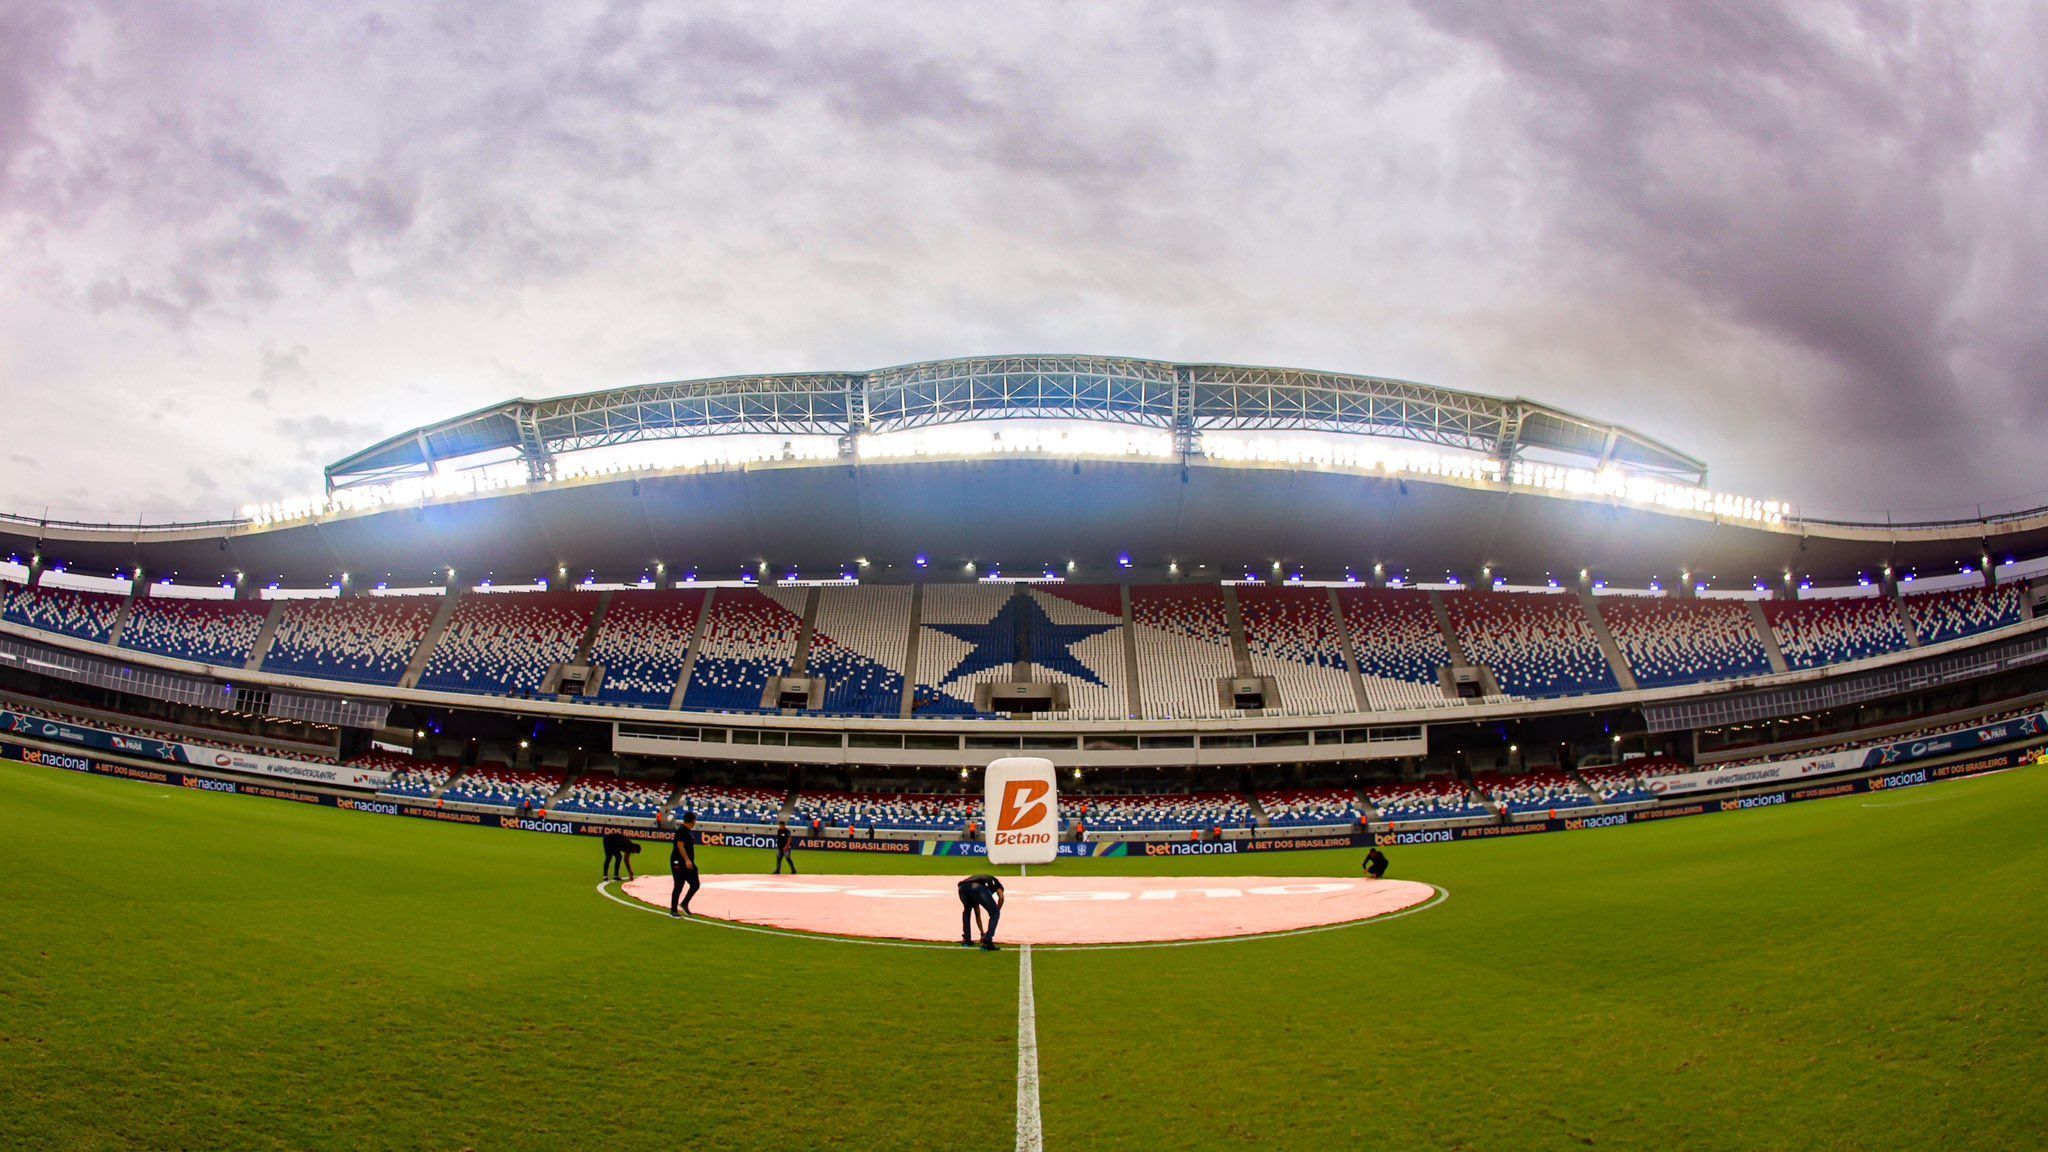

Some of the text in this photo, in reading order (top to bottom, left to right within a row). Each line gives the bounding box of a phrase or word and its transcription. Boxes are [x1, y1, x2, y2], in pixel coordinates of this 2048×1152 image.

[23, 747, 88, 770] betnacional
[1933, 768, 1939, 776] A
[1938, 766, 1950, 776] BET
[1951, 764, 1964, 774] DOS
[1966, 756, 2008, 772] BRASILEIROS
[96, 762, 166, 781] A BET DOS BRASILEIROS
[1868, 768, 1926, 790] betnacional
[183, 775, 236, 792] betnacional
[337, 797, 398, 815] betnacional
[1721, 792, 1786, 810] betnacional
[410, 808, 421, 816] BET
[423, 810, 437, 818] DOS
[438, 812, 480, 822] BRASILEIROS
[1565, 813, 1627, 830] betnacional
[500, 816, 572, 834] betnacional
[587, 826, 603, 834] BET
[623, 830, 675, 840] BRASILEIROS
[1501, 824, 1546, 834] BRASILEIROS
[702, 832, 778, 848] betnacion
[808, 840, 825, 848] BET
[827, 841, 847, 849] DOS
[849, 841, 910, 851] BRASILEIROS
[994, 832, 1050, 845] Betano
[1247, 838, 1351, 850] A BET DOS BRASILEIROS
[1375, 830, 1453, 845] betnacional
[973, 844, 987, 854] Cop
[1146, 840, 1238, 855] betnacional
